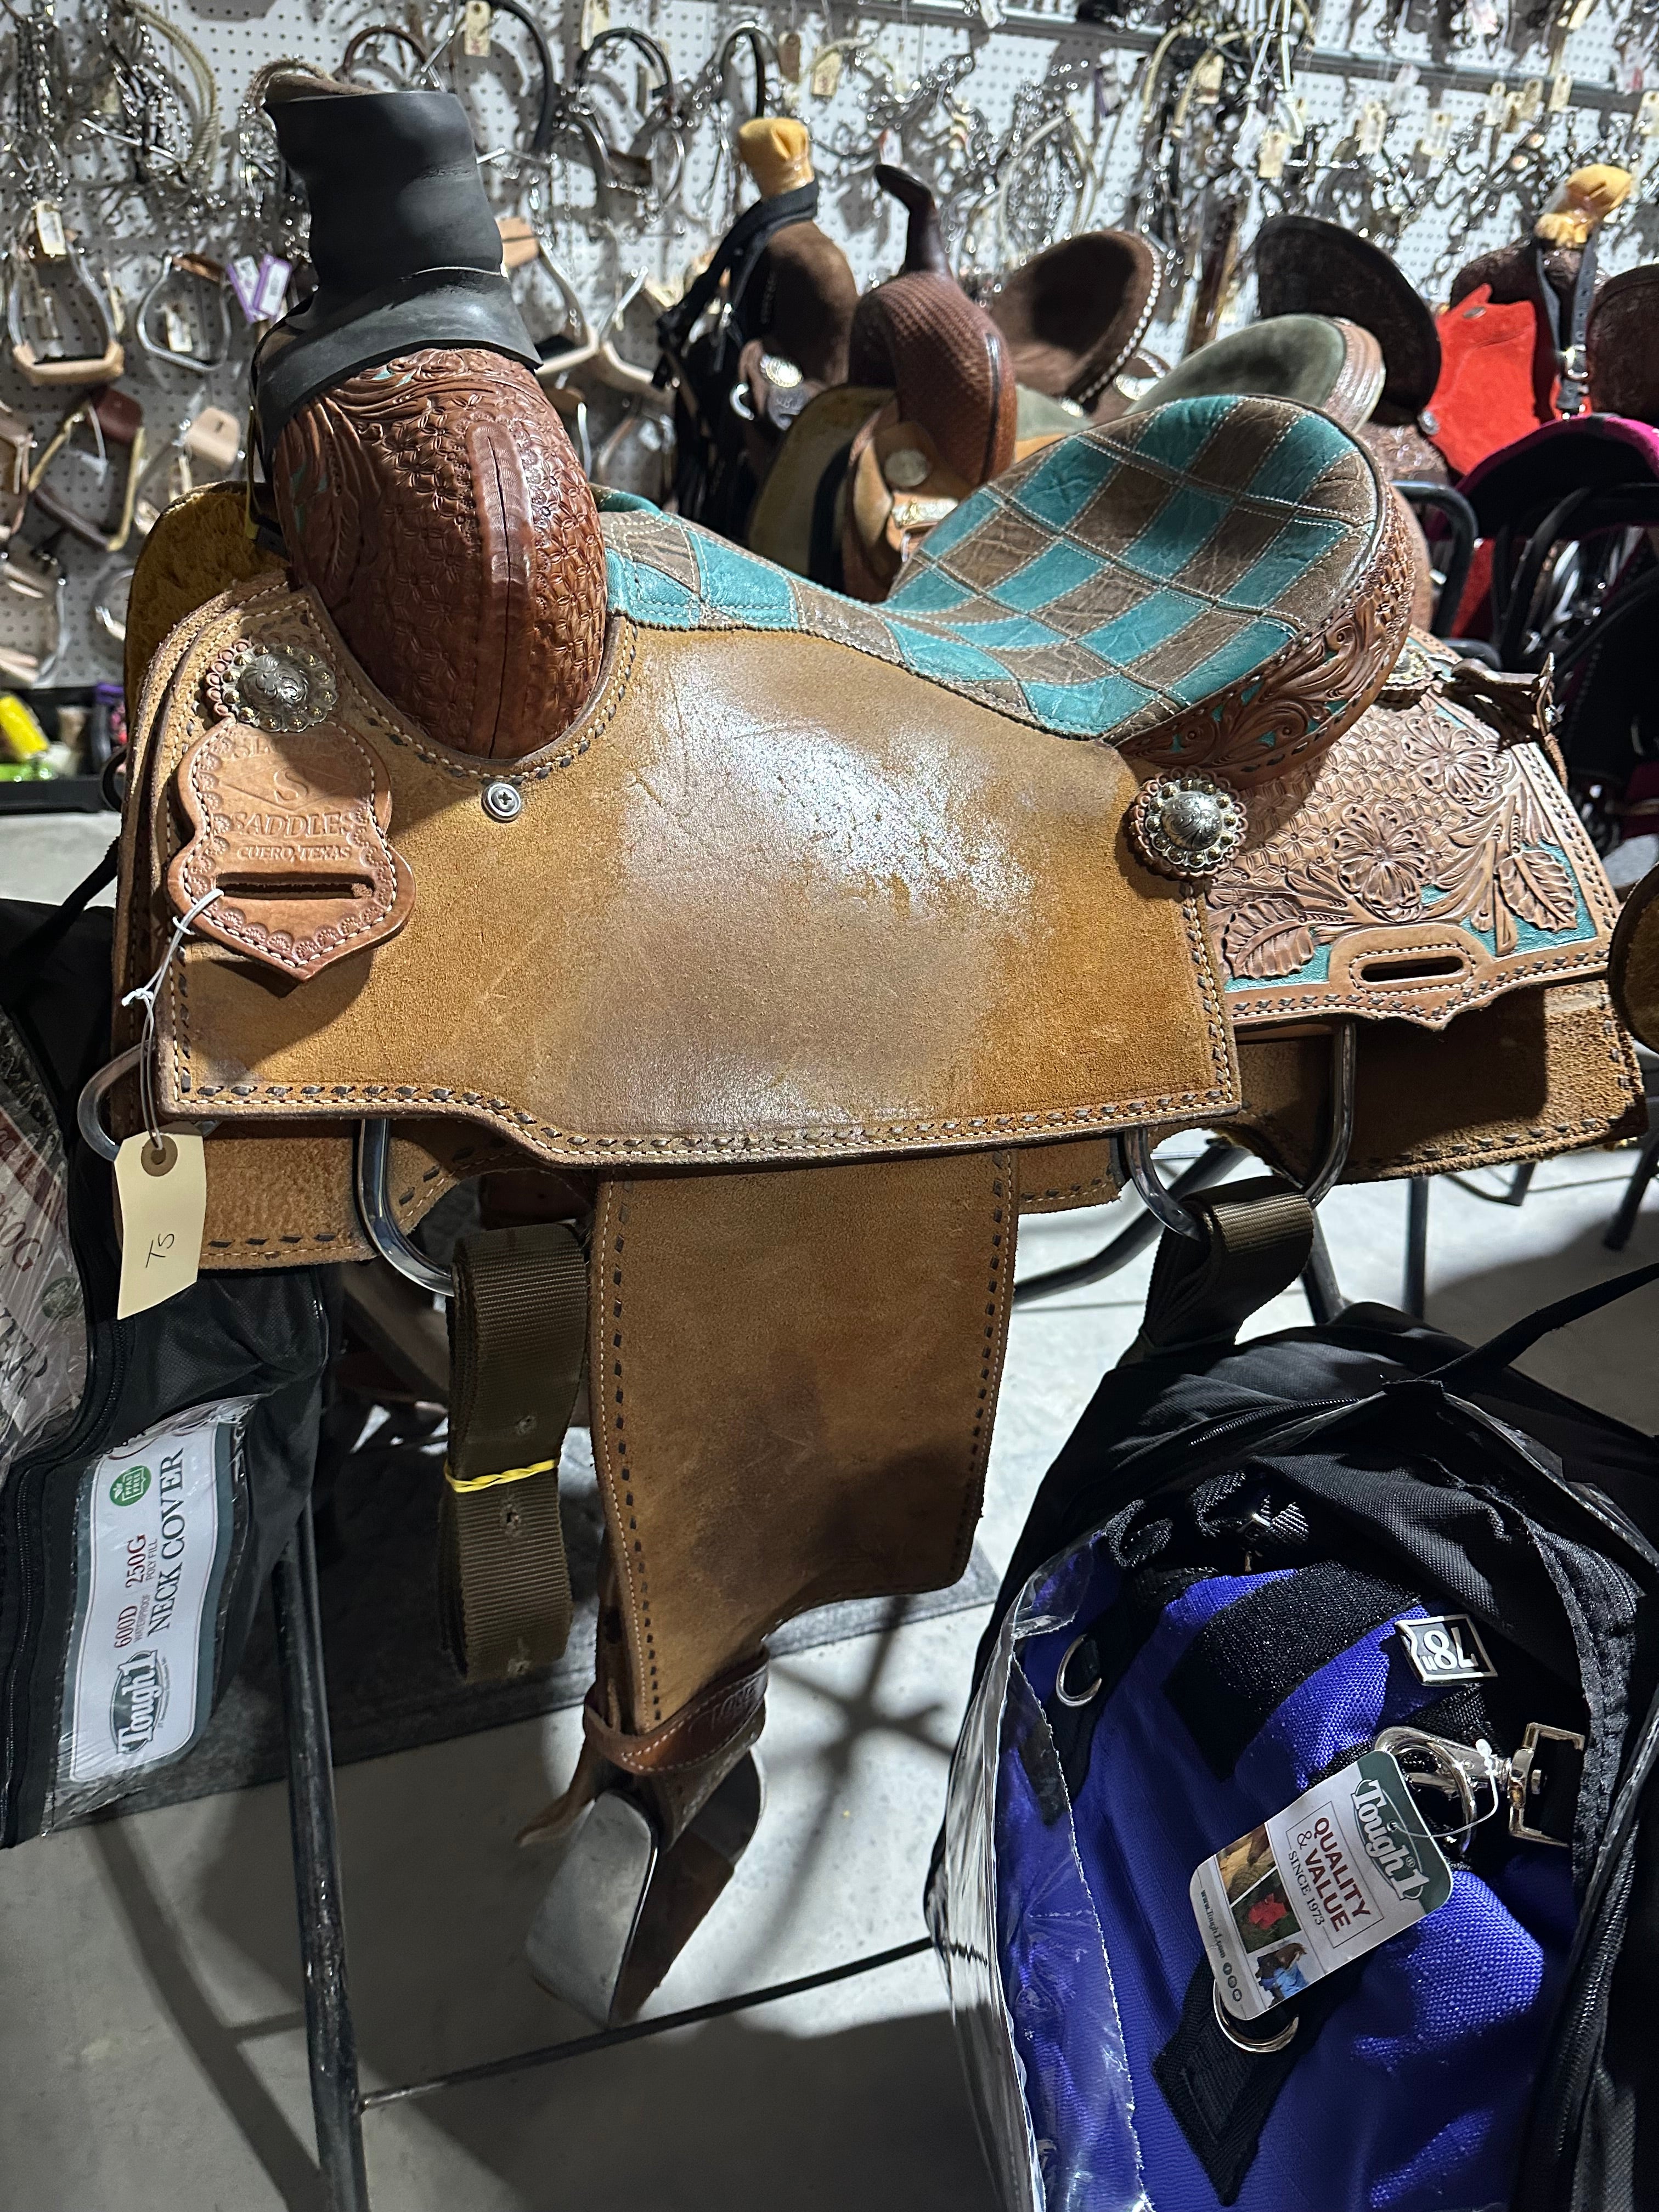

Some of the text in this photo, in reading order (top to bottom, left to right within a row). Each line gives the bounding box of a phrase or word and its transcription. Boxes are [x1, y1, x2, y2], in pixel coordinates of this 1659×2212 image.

[233, 811, 355, 839] SADDLES
[298, 844, 353, 861] TEXAS
[160, 1447, 185, 1560] COVER
[114, 1534, 146, 1648] 600D 250G
[145, 1538, 157, 1581] POLY FILL
[133, 1594, 150, 1643] WATERPROOF
[146, 1561, 183, 1637] NECK
[1289, 1850, 1325, 1926] SINCE 1973
[1297, 1830, 1351, 1932] & VALUE
[1313, 1817, 1371, 1917] QUALITY
[1200, 1889, 1226, 1959] www.Tough1.com
